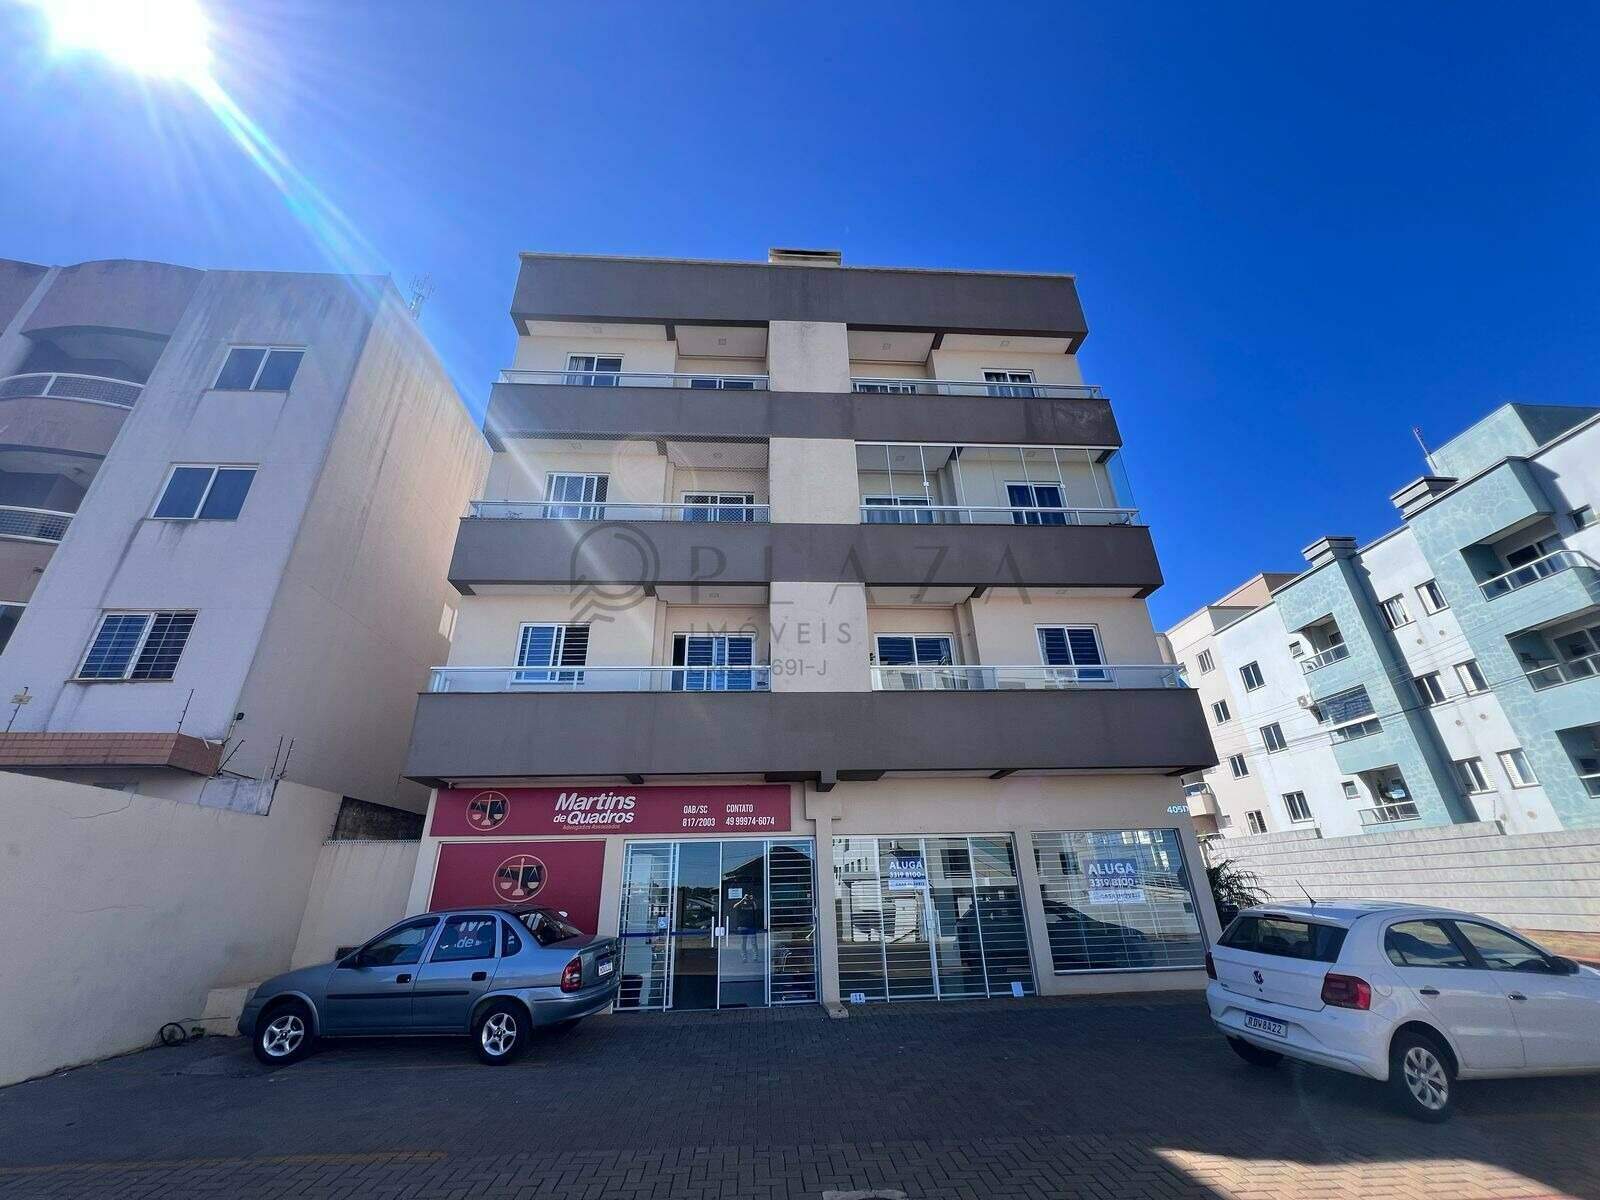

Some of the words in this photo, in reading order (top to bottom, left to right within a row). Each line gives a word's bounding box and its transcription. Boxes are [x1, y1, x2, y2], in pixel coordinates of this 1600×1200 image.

[554, 792, 636, 811] Martins
[683, 805, 708, 814] OAB/SC
[726, 804, 754, 813] CONTATO
[553, 813, 567, 823] de
[567, 810, 635, 825] Quadros
[725, 816, 735, 826] 49
[735, 816, 775, 826] 99974-6074
[682, 818, 716, 827] 817/2003
[890, 861, 924, 870] ALUGA
[1088, 862, 1136, 875] ALUGA
